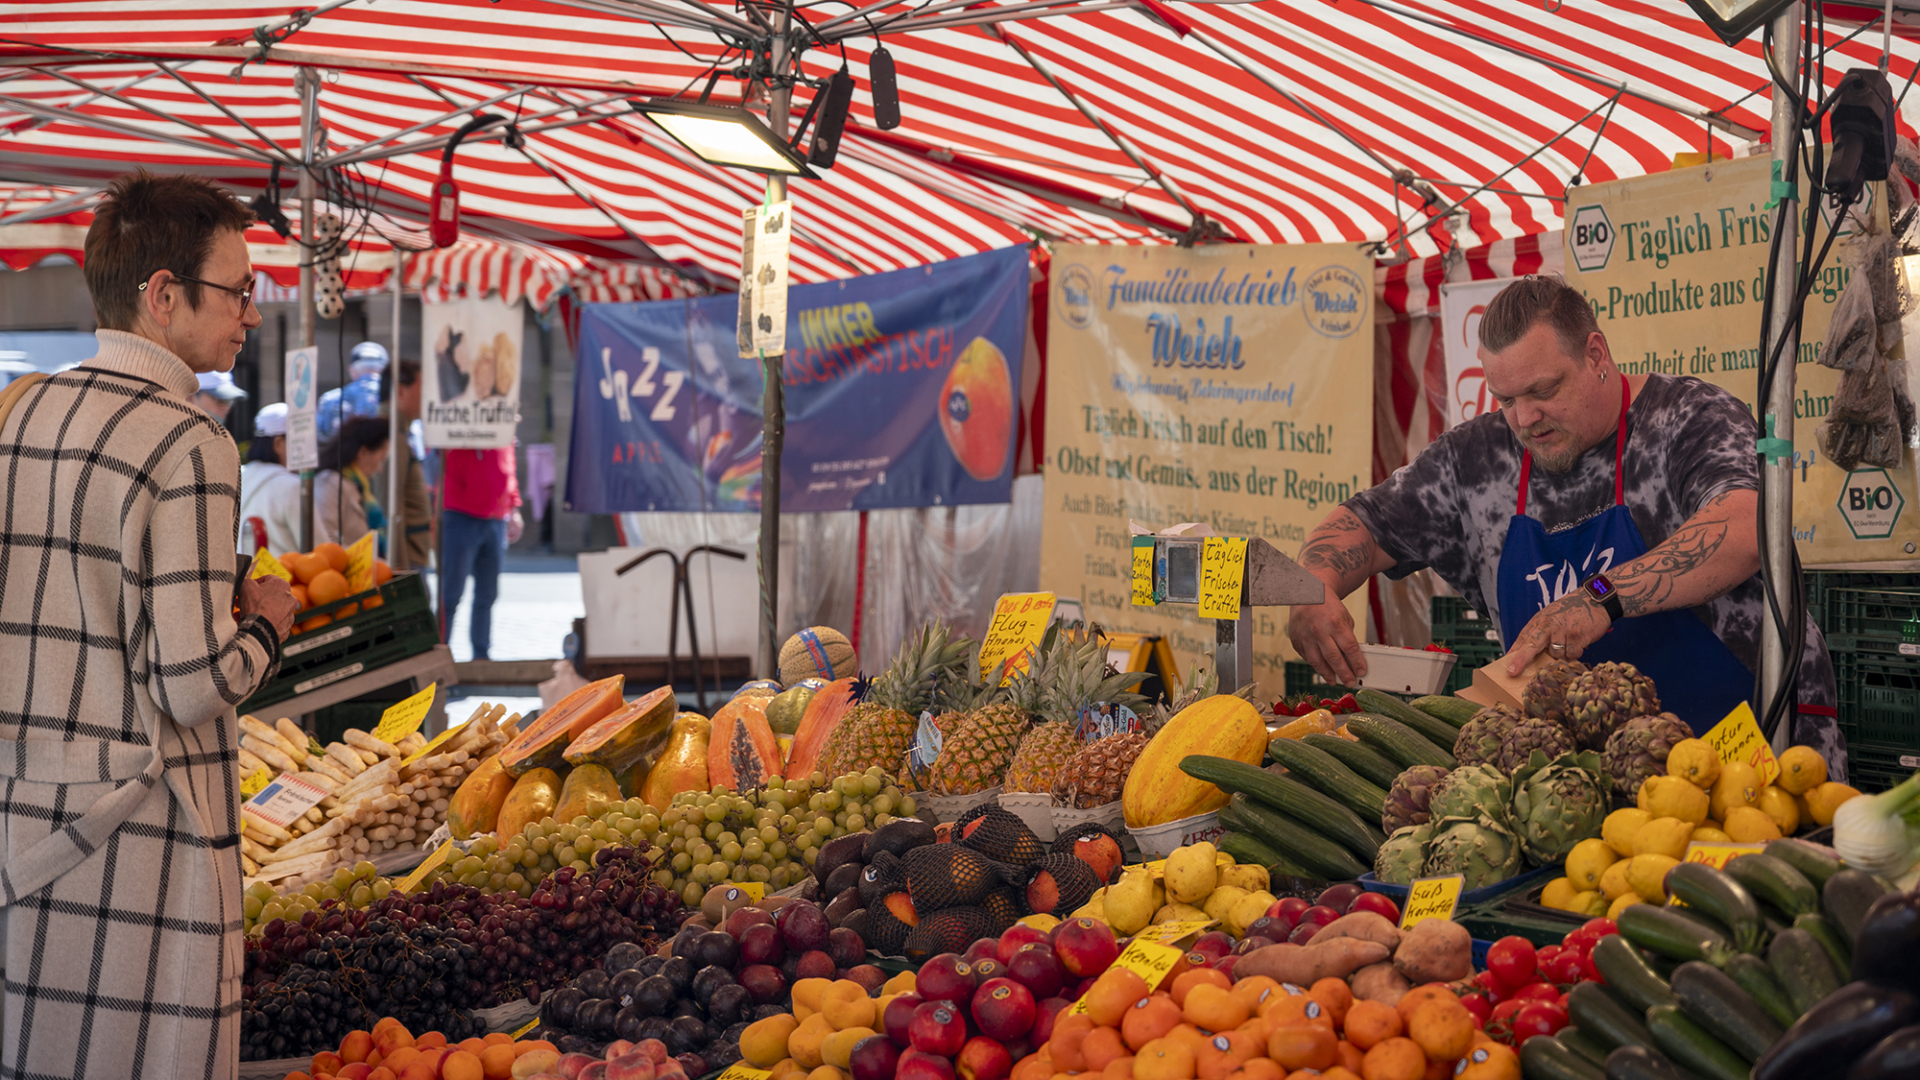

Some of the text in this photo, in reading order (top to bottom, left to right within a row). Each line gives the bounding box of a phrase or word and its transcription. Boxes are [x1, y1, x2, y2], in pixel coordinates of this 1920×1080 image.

[1620, 211, 1713, 270] Täglich
[1100, 263, 1297, 311] Familienbetrieb
[1311, 290, 1358, 313] Weich
[1709, 277, 1746, 308] aus
[799, 301, 883, 350] IMMER
[1145, 310, 1246, 370] Weich
[1690, 345, 1716, 374] die
[1721, 347, 1760, 372] man
[599, 346, 685, 423] JAZZ
[1197, 416, 1229, 447] auf
[1232, 418, 1268, 450] den
[1272, 420, 1334, 456] Tisch!
[1057, 445, 1101, 477] Obst
[1208, 469, 1241, 494] aus
[1246, 464, 1278, 497] der
[1283, 467, 1358, 511] Region!
[1206, 542, 1246, 569] Täglich
[1203, 592, 1240, 614] Trüffel
